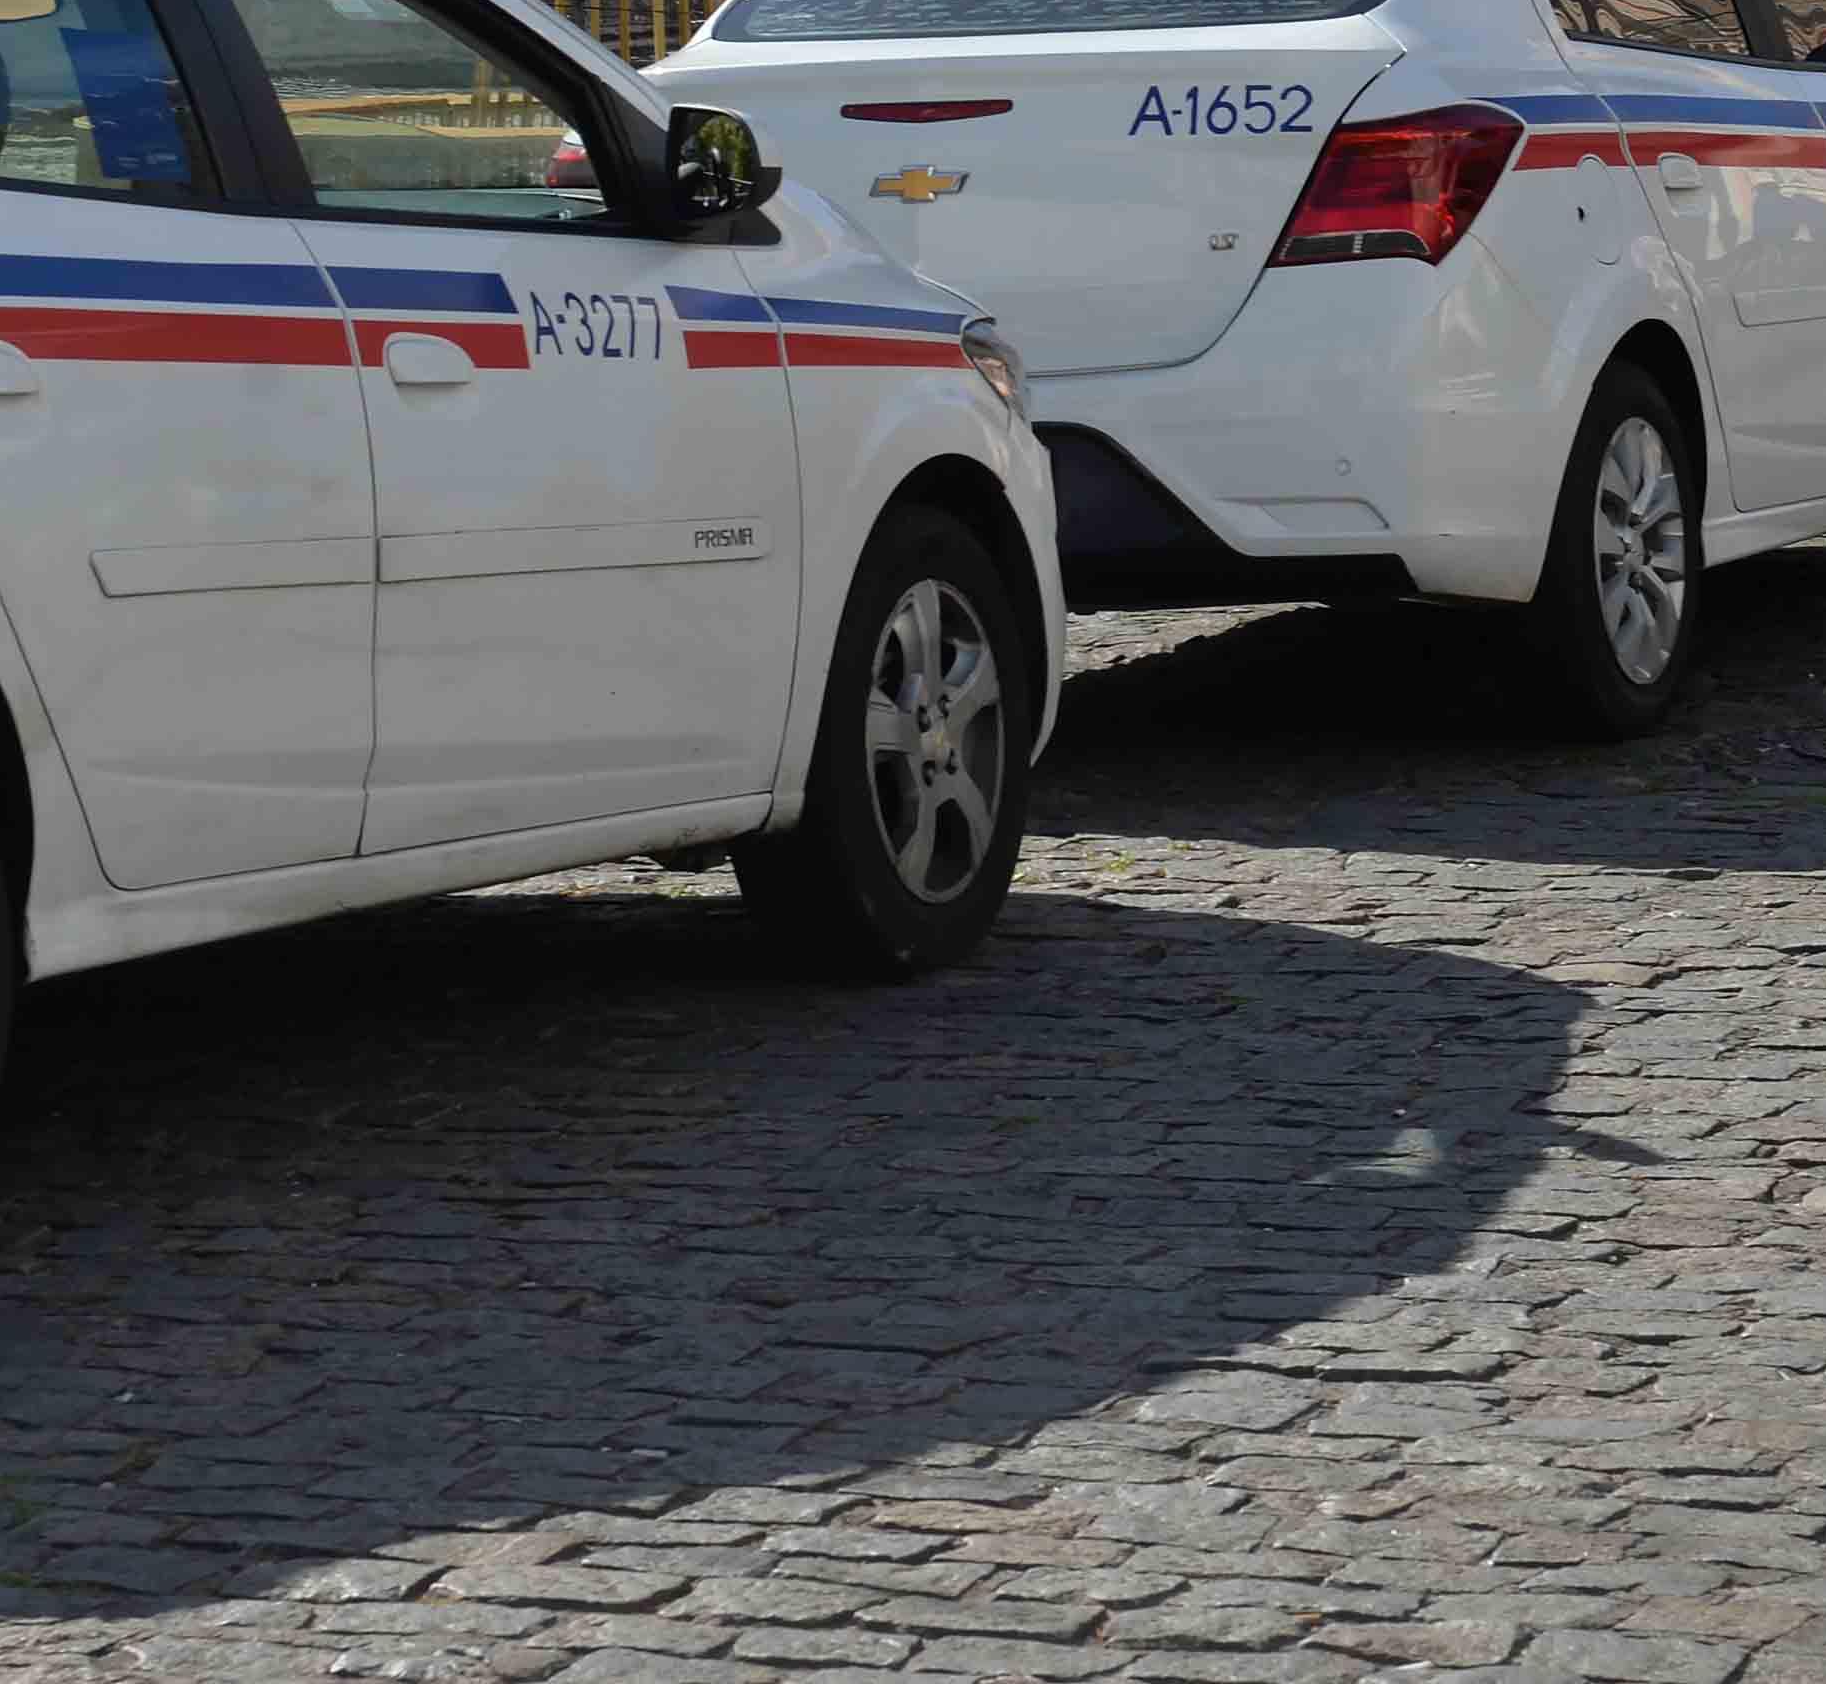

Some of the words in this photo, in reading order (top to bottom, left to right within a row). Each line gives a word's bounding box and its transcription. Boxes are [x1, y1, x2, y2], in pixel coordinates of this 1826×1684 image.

[1128, 85, 1313, 136] A-1652
[530, 290, 662, 360] A-3277
[694, 527, 754, 549] PRISMA
